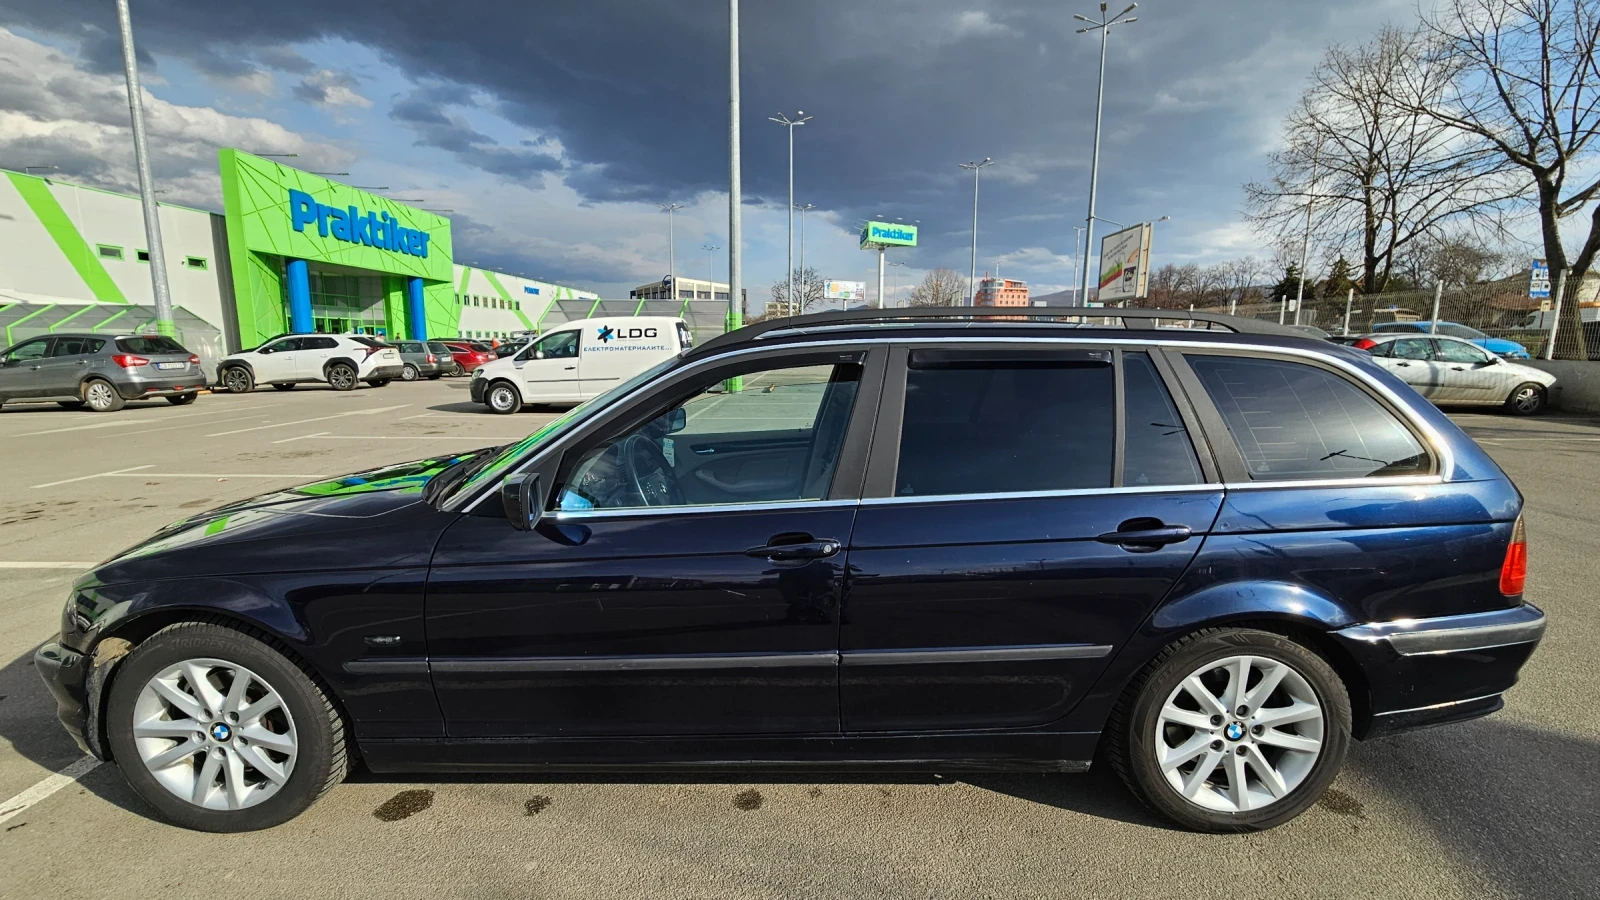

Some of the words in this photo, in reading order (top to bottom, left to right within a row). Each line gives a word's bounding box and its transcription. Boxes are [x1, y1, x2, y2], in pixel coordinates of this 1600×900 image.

[288, 188, 430, 259] Praktiker
[872, 226, 914, 241] Praktiker
[617, 328, 657, 338] LDG
